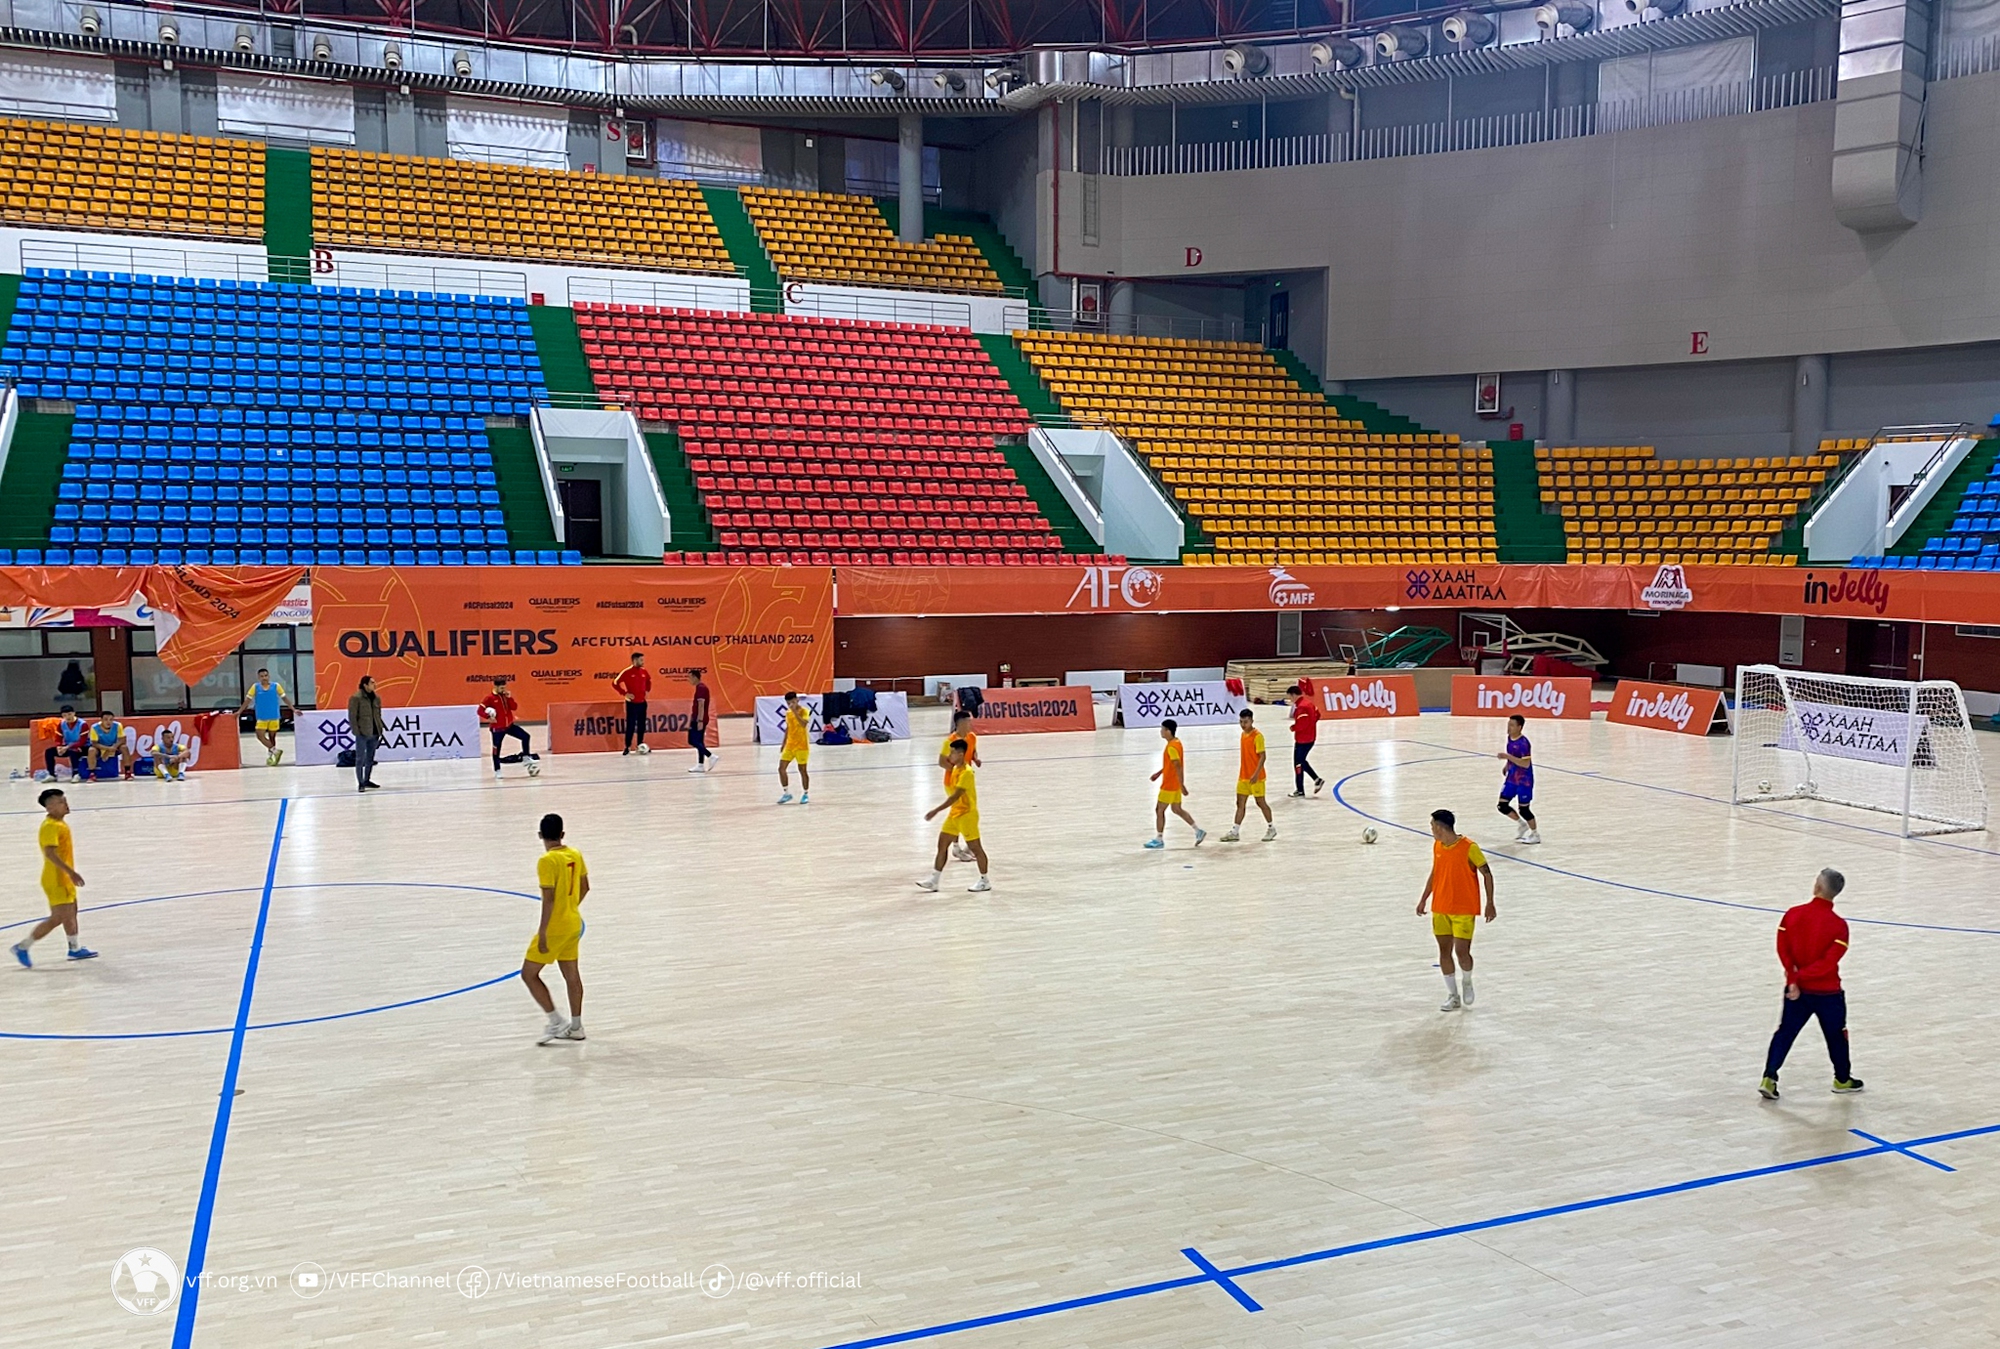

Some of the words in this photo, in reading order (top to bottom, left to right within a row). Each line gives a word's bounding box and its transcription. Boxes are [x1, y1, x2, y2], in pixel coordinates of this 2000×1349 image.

[607, 121, 621, 141] S
[313, 249, 334, 273] B
[1185, 247, 1203, 267] D
[786, 283, 804, 304] C
[1690, 331, 1709, 354] E
[1431, 569, 1475, 583] ХААН
[1065, 567, 1161, 607] AFC
[1431, 585, 1507, 600] ДААТГАЛ
[1644, 591, 1690, 599] MORINAGA
[209, 596, 242, 619] 2024
[657, 597, 706, 605] QUALIFIERS
[1288, 592, 1315, 605] MFF
[338, 628, 559, 658] QUALIFIERS
[571, 636, 598, 647] AFC
[600, 636, 650, 647] FUTSAL
[652, 635, 693, 646] ASIAN
[694, 635, 720, 645] CUP
[725, 634, 785, 645] THAILAND
[788, 634, 814, 644] 2024
[531, 669, 583, 677] QUALIFIERS
[1161, 688, 1205, 702] ХААН
[1164, 702, 1235, 717] ДААТГАЛ
[1825, 712, 1874, 732] ХААН
[376, 731, 464, 750] ААТГАЛ
[567, 862, 576, 896] 7
